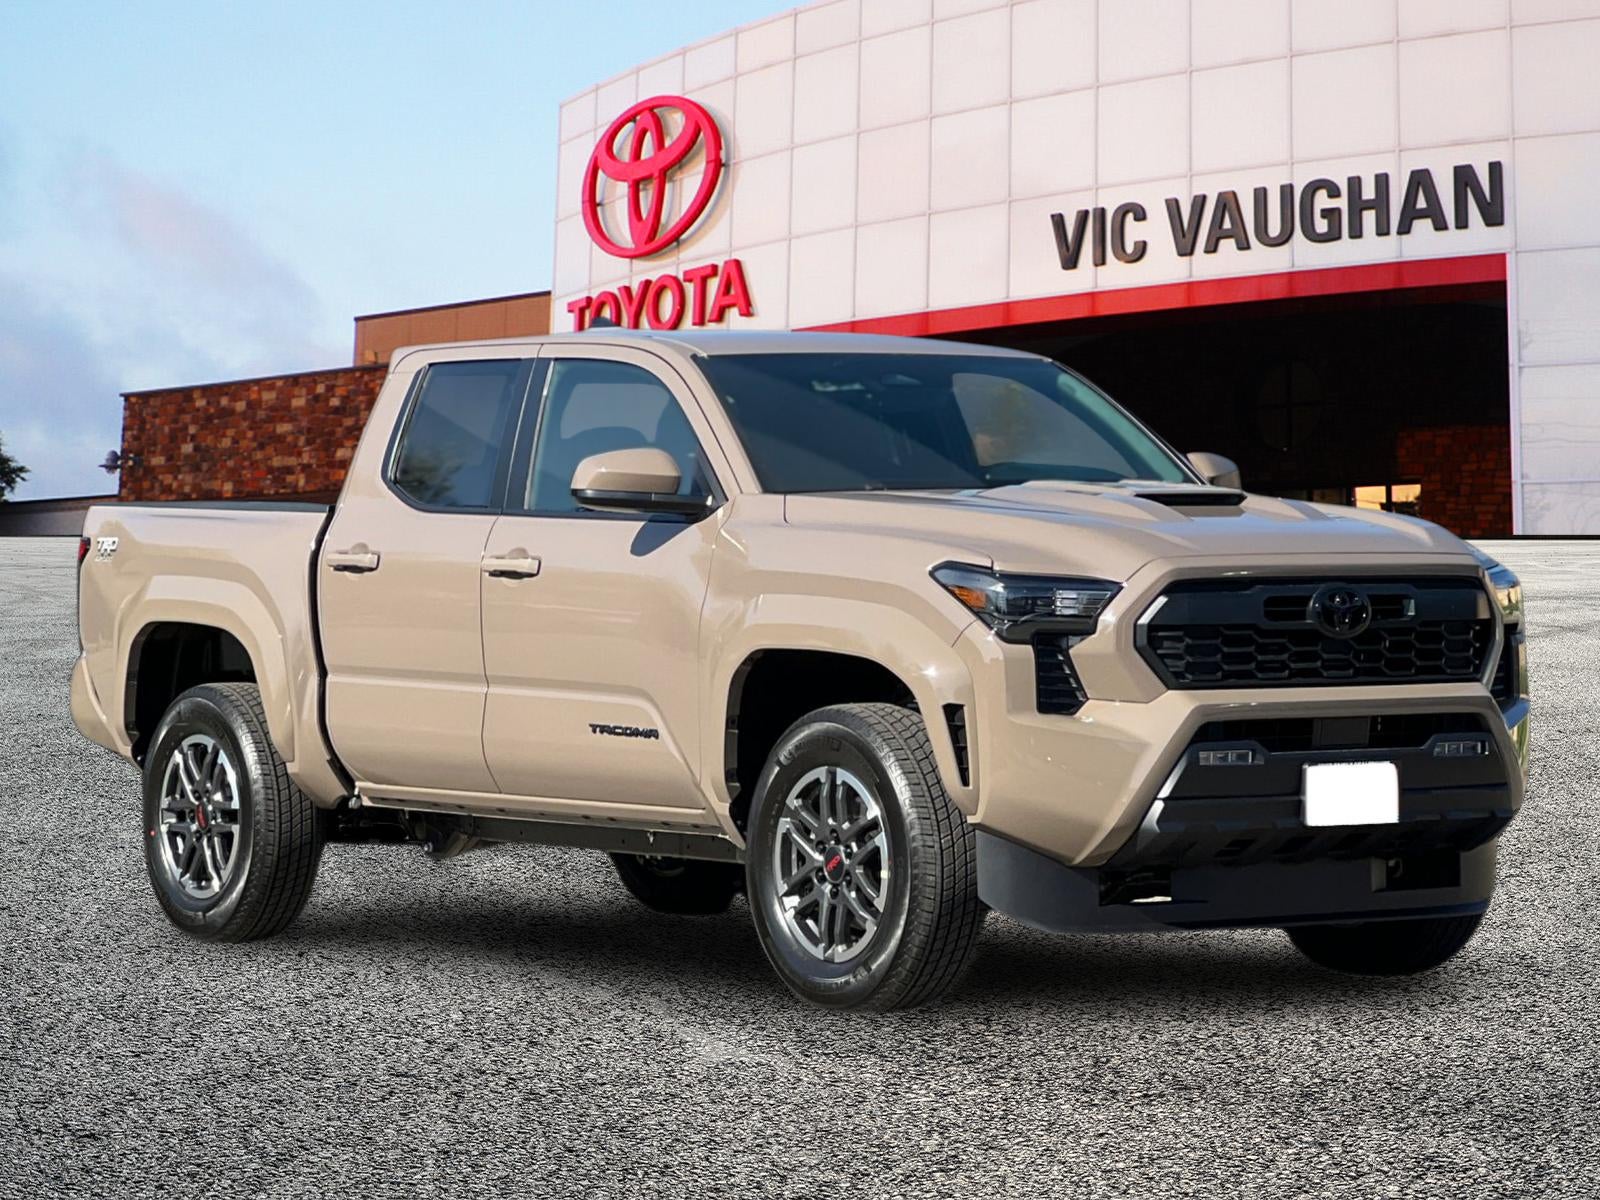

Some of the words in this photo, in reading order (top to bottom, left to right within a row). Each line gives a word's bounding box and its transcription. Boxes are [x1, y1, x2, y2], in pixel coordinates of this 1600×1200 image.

[1050, 201, 1147, 271] VIC
[1164, 160, 1505, 258] VAUGHAN
[567, 259, 755, 332] TOYOTA
[588, 723, 660, 740] TACOMA
